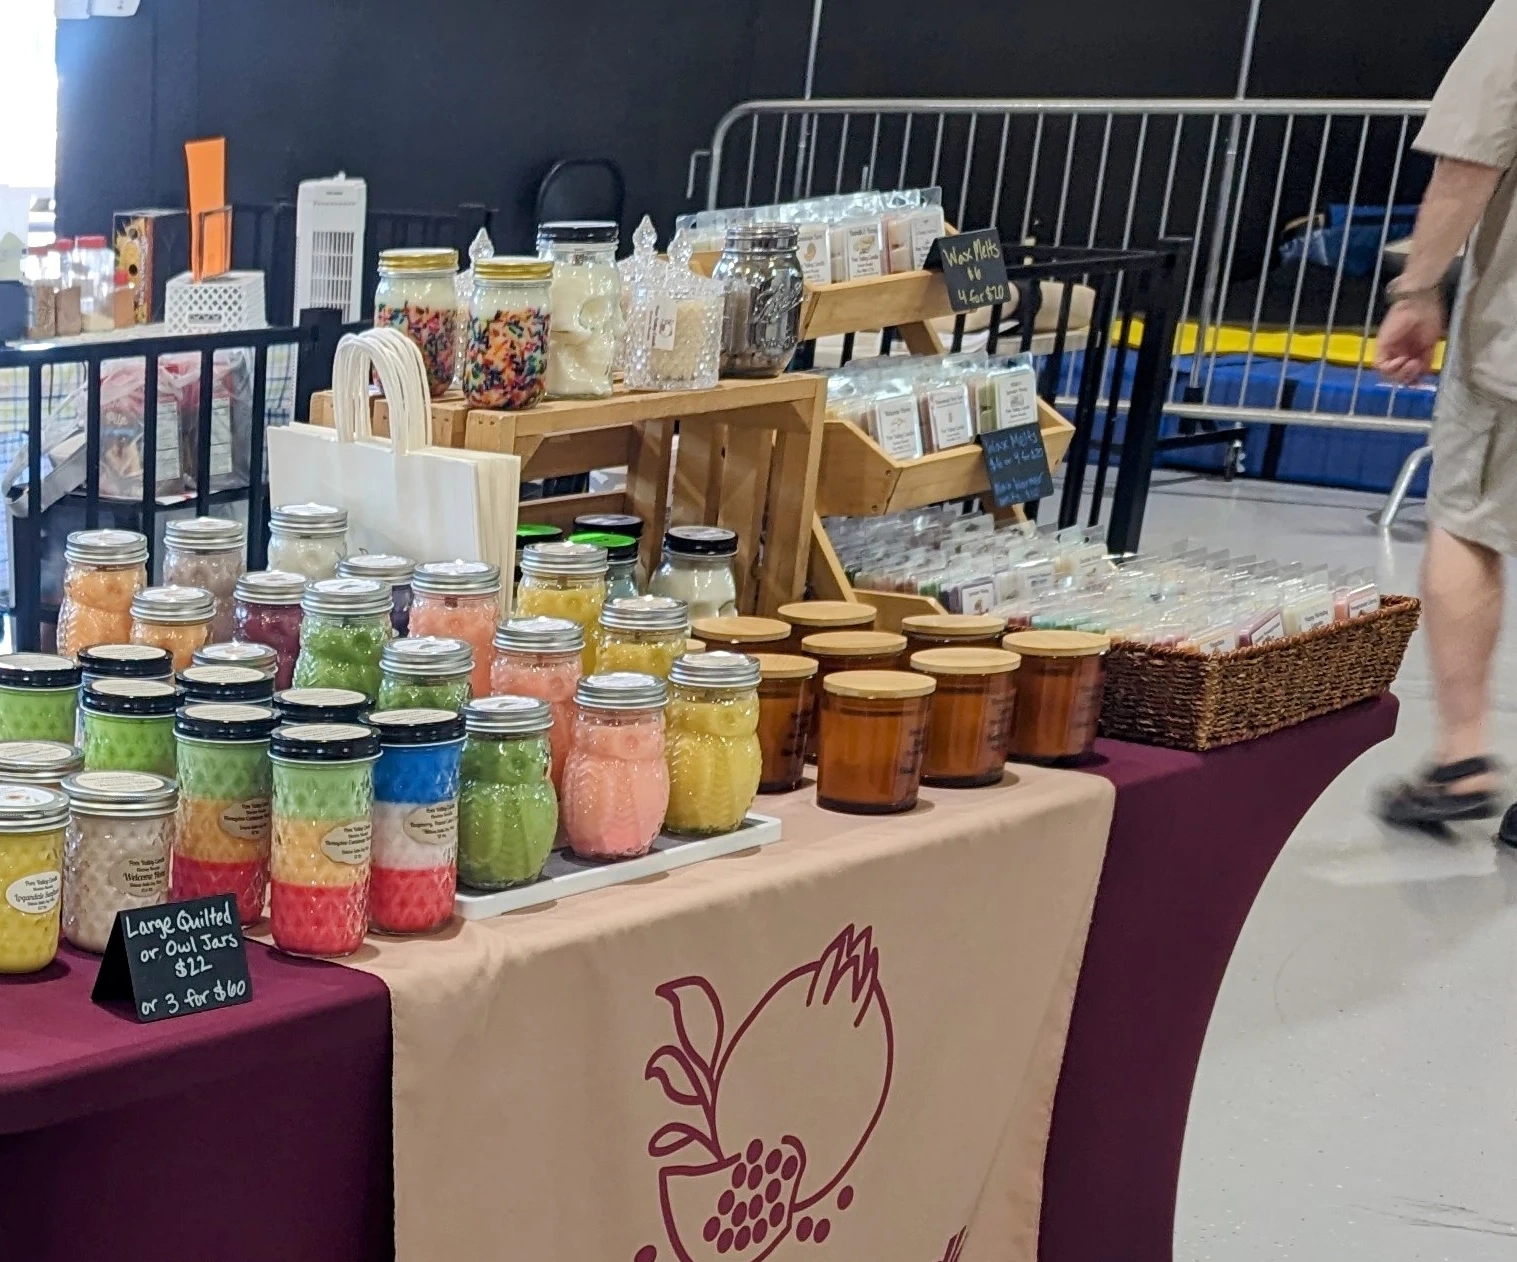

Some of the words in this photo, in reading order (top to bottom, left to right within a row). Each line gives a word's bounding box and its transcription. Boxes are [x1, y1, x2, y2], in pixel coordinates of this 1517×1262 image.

[943, 245, 973, 267] Wax
[958, 289, 967, 304] 4
[125, 915, 175, 940] Large
[176, 901, 232, 933] Quilted
[140, 946, 160, 963] or
[165, 936, 197, 957] Owl
[200, 933, 238, 951] Jars
[175, 955, 213, 978] $22
[141, 998, 158, 1015] or
[165, 993, 179, 1014] 3
[184, 988, 210, 1008] for
[213, 979, 246, 1002] $60
